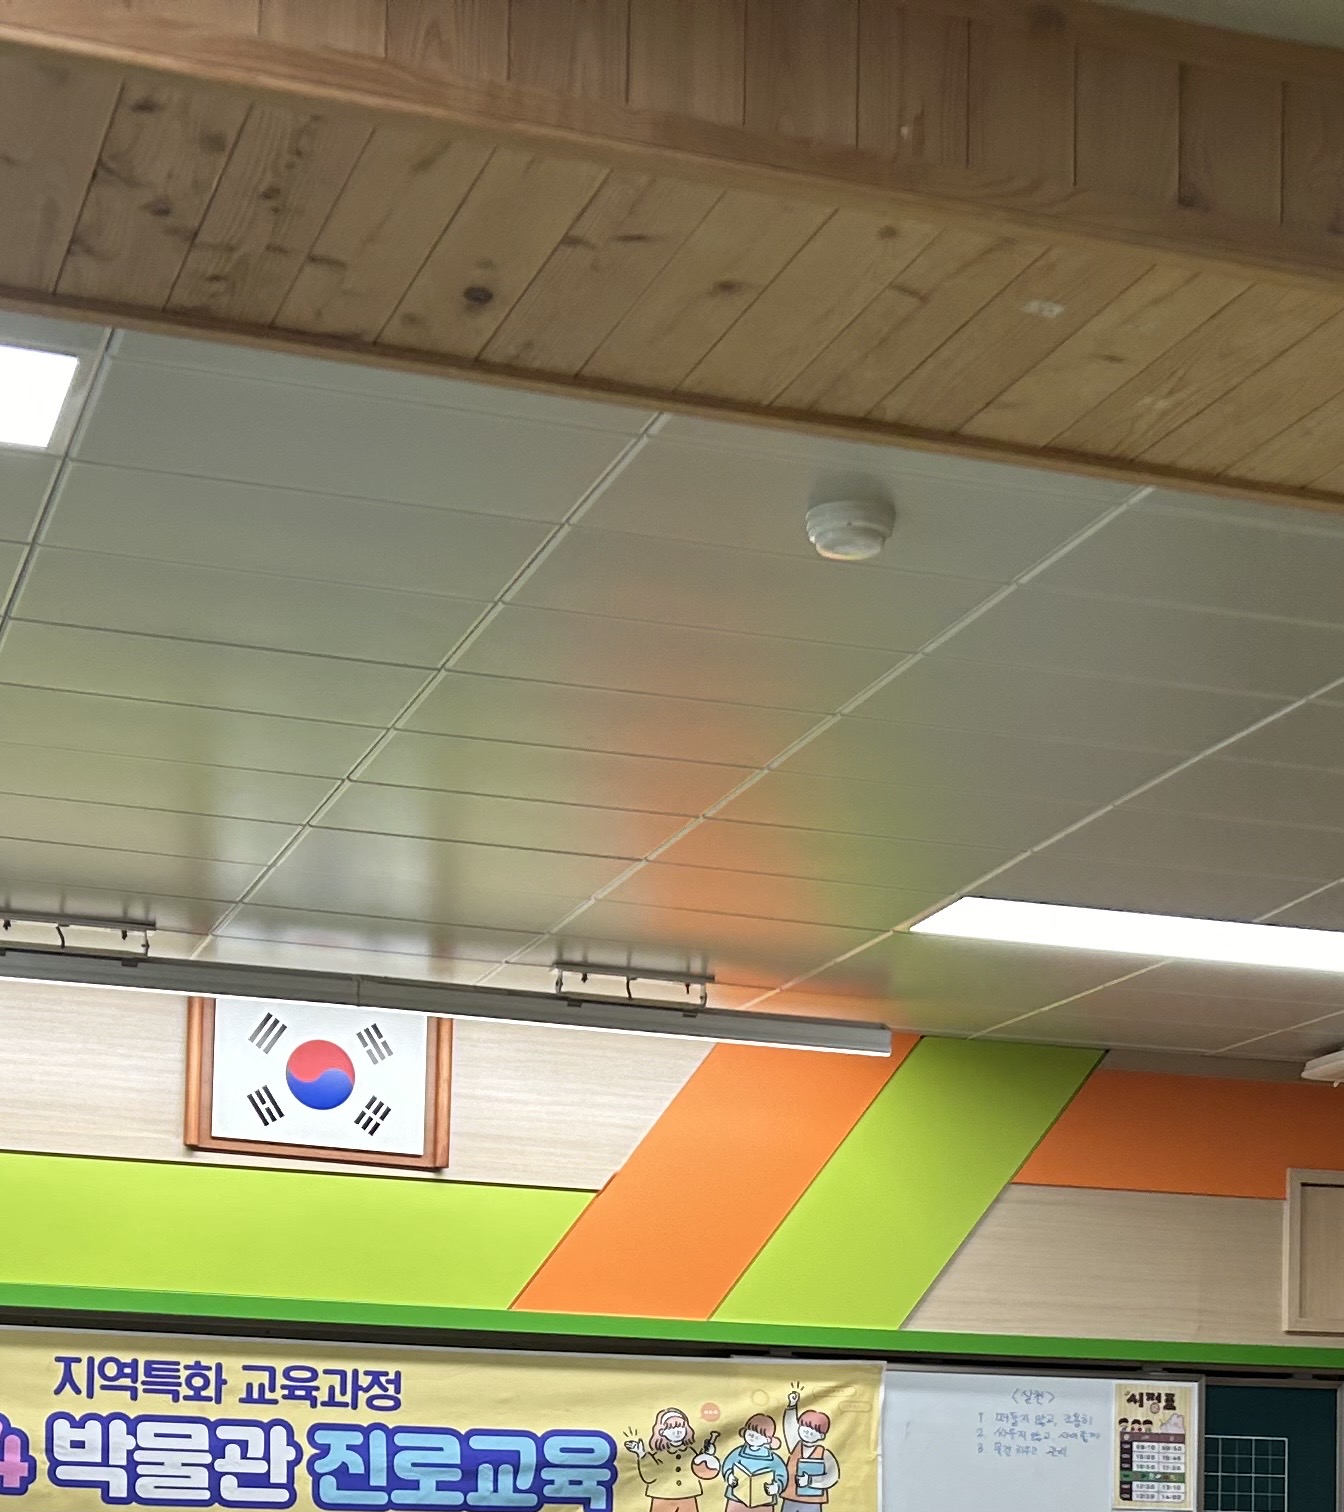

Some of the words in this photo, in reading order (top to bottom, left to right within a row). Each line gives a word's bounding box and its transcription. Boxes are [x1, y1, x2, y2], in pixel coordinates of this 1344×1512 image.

[54, 1355, 227, 1406] 지역특화
[238, 1362, 402, 1412] 교육과정
[48, 1413, 301, 1506] 박물관
